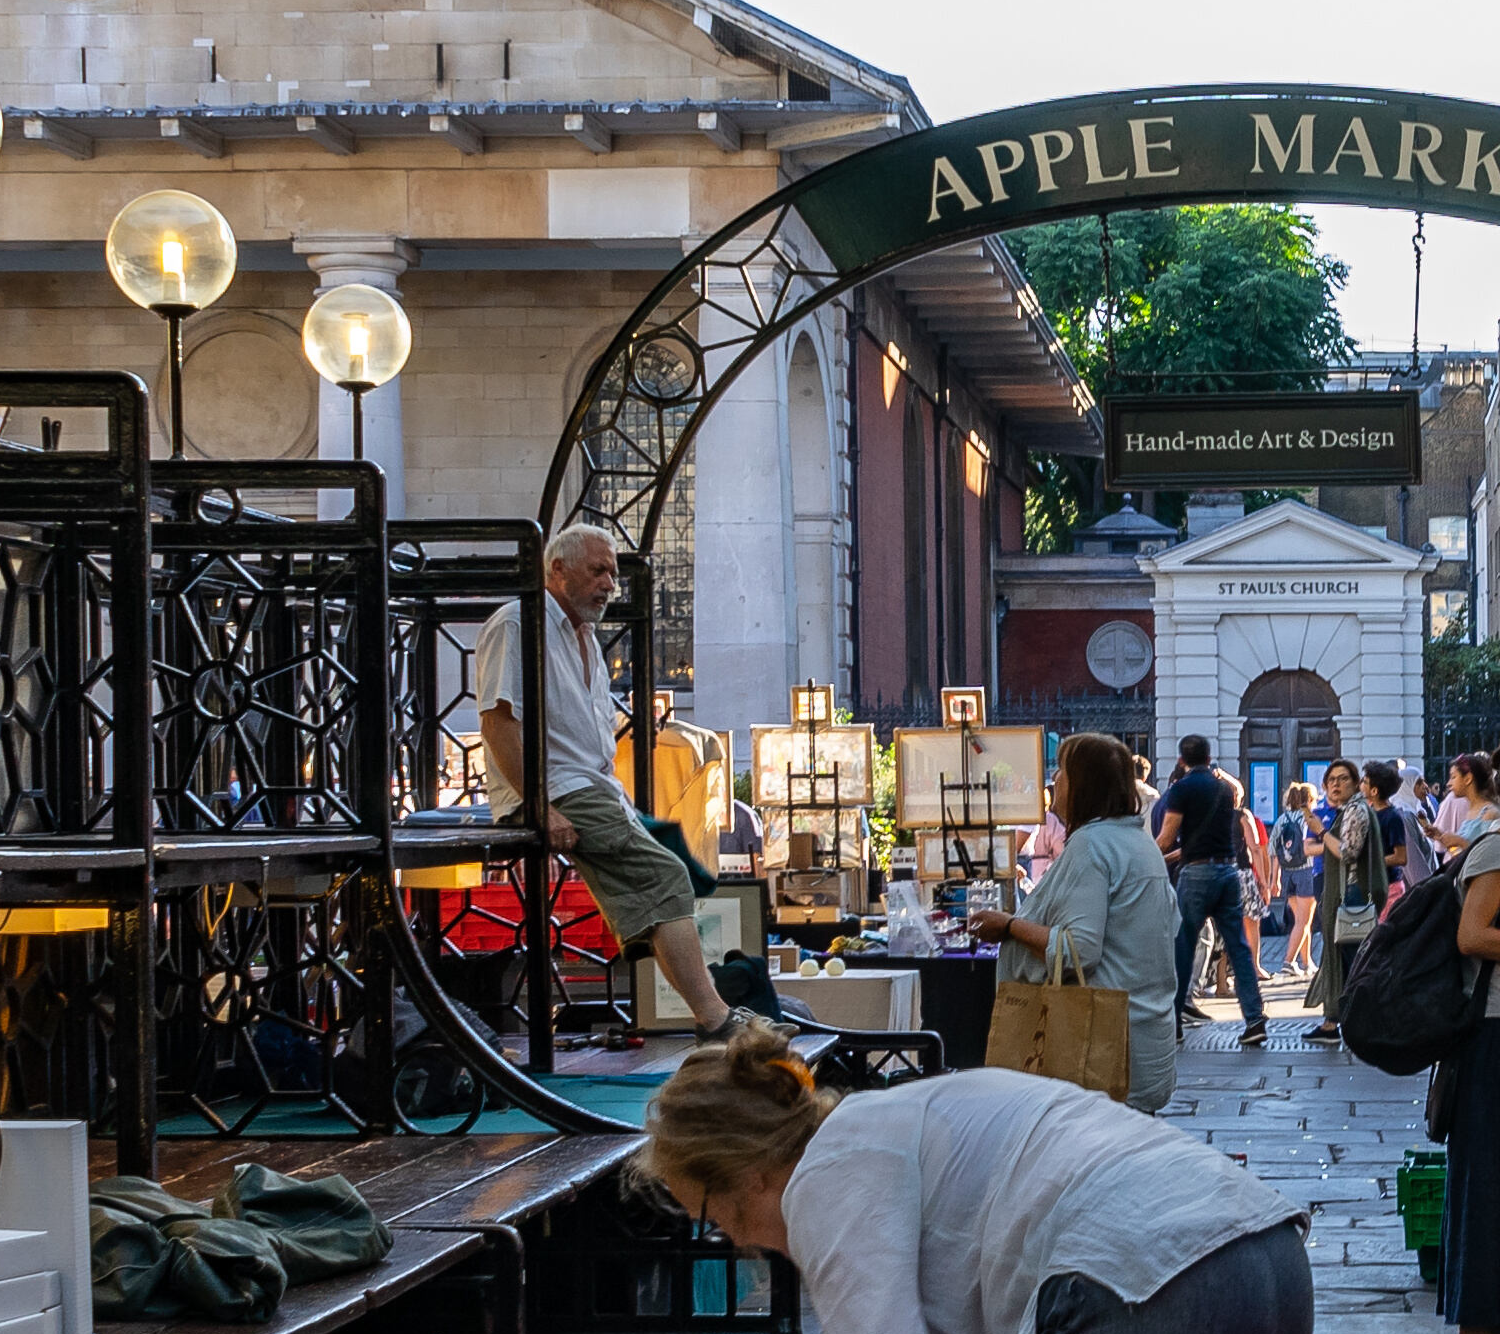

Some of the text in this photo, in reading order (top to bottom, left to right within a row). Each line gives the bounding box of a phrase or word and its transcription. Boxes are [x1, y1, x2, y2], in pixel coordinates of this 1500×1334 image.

[927, 116, 1180, 223] APPLE
[1125, 427, 1395, 452] Hand-made Art & Design
[1218, 581, 1359, 595] ST PAUL'S CHURCH
